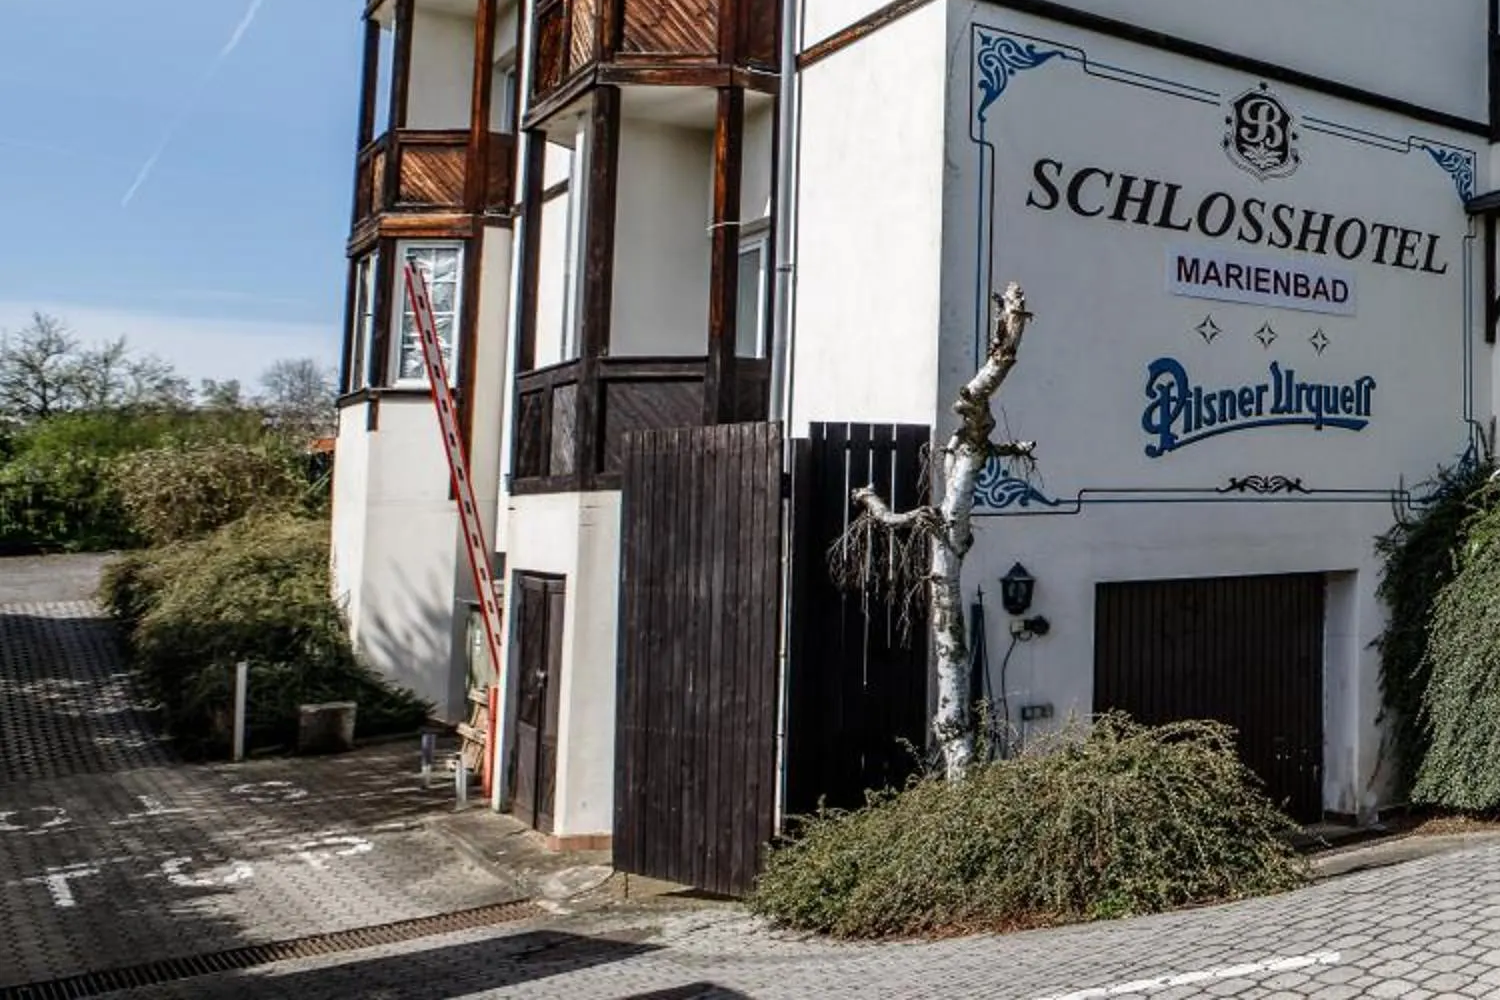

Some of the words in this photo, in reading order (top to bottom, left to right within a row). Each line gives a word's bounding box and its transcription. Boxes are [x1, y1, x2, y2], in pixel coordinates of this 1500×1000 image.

[1025, 157, 1449, 275] SCHLOSSHOTEL
[1176, 255, 1350, 304] MARIENBAD
[1141, 357, 1270, 458] Pilsner
[1268, 360, 1377, 431] Urquell
